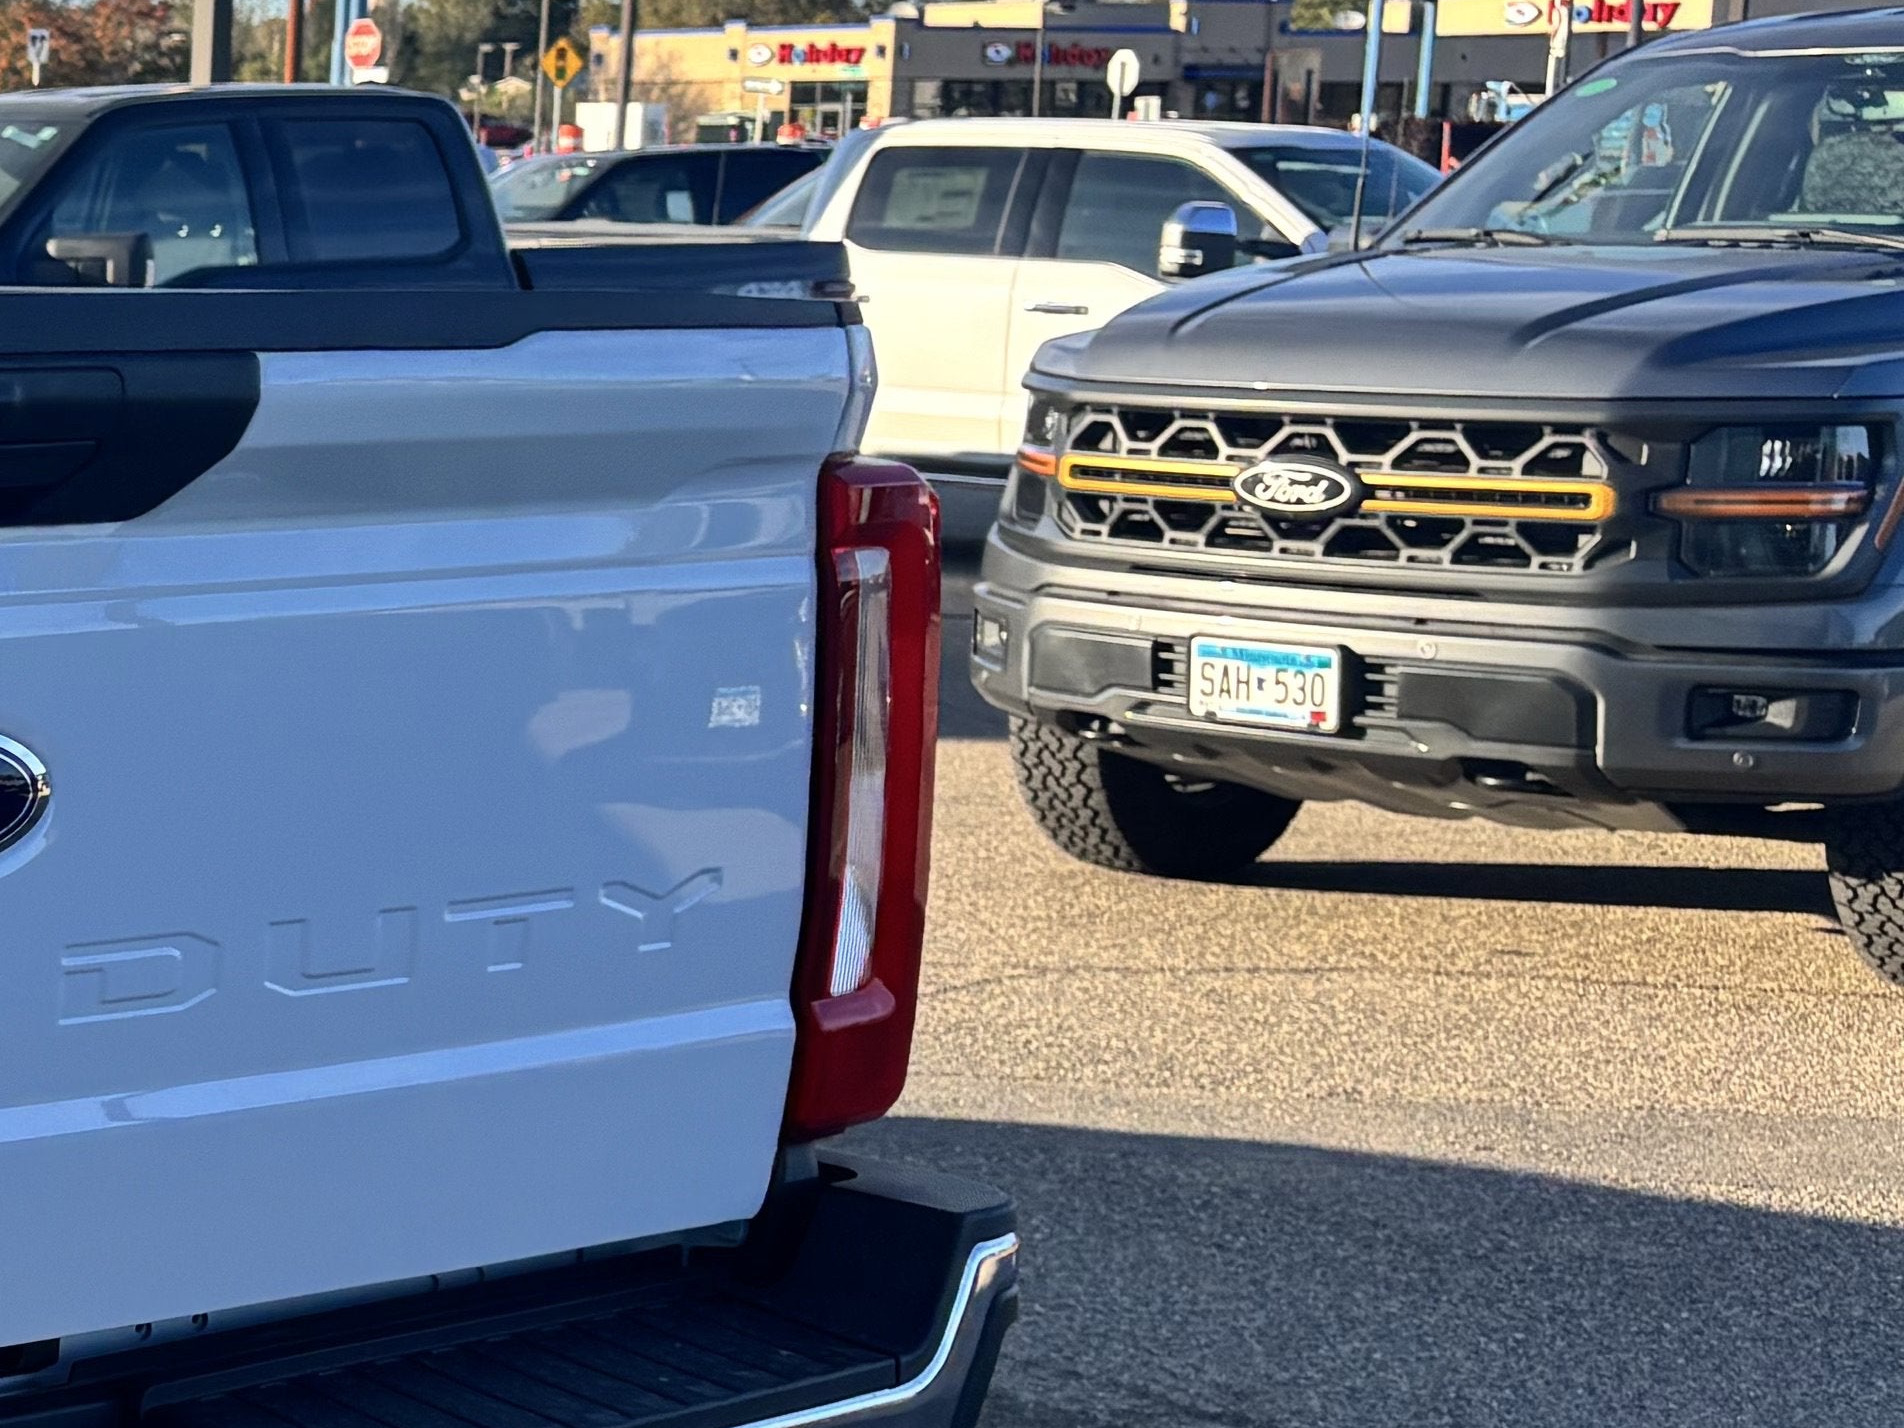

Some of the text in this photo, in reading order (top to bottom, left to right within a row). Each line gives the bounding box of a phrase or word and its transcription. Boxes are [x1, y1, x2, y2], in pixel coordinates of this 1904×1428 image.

[1254, 470, 1330, 504] Ford
[1200, 662, 1325, 708] SAH 530
[58, 865, 724, 1028] DUTY
